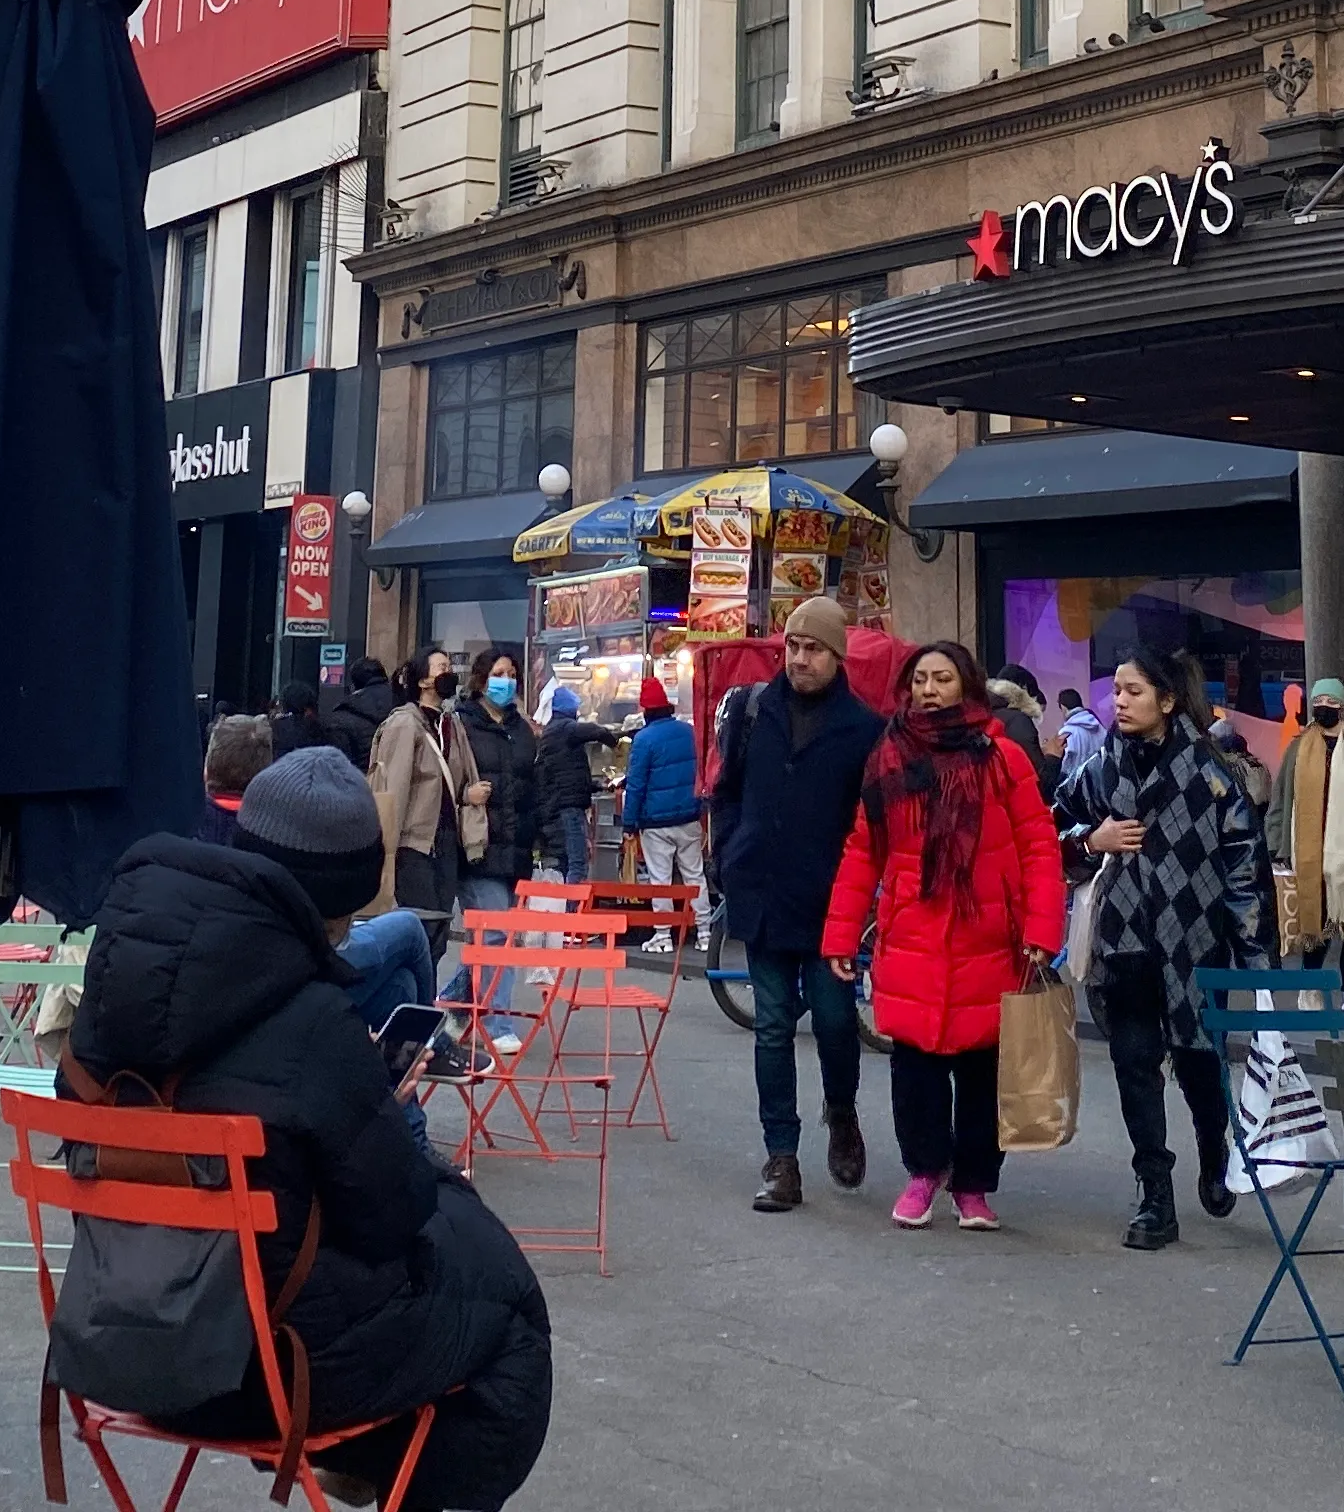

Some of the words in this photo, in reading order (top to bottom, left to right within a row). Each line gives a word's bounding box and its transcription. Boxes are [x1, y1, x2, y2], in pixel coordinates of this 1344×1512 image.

[300, 517, 327, 534] KING
[295, 546, 328, 561] NOW
[291, 561, 329, 577] OPEN
